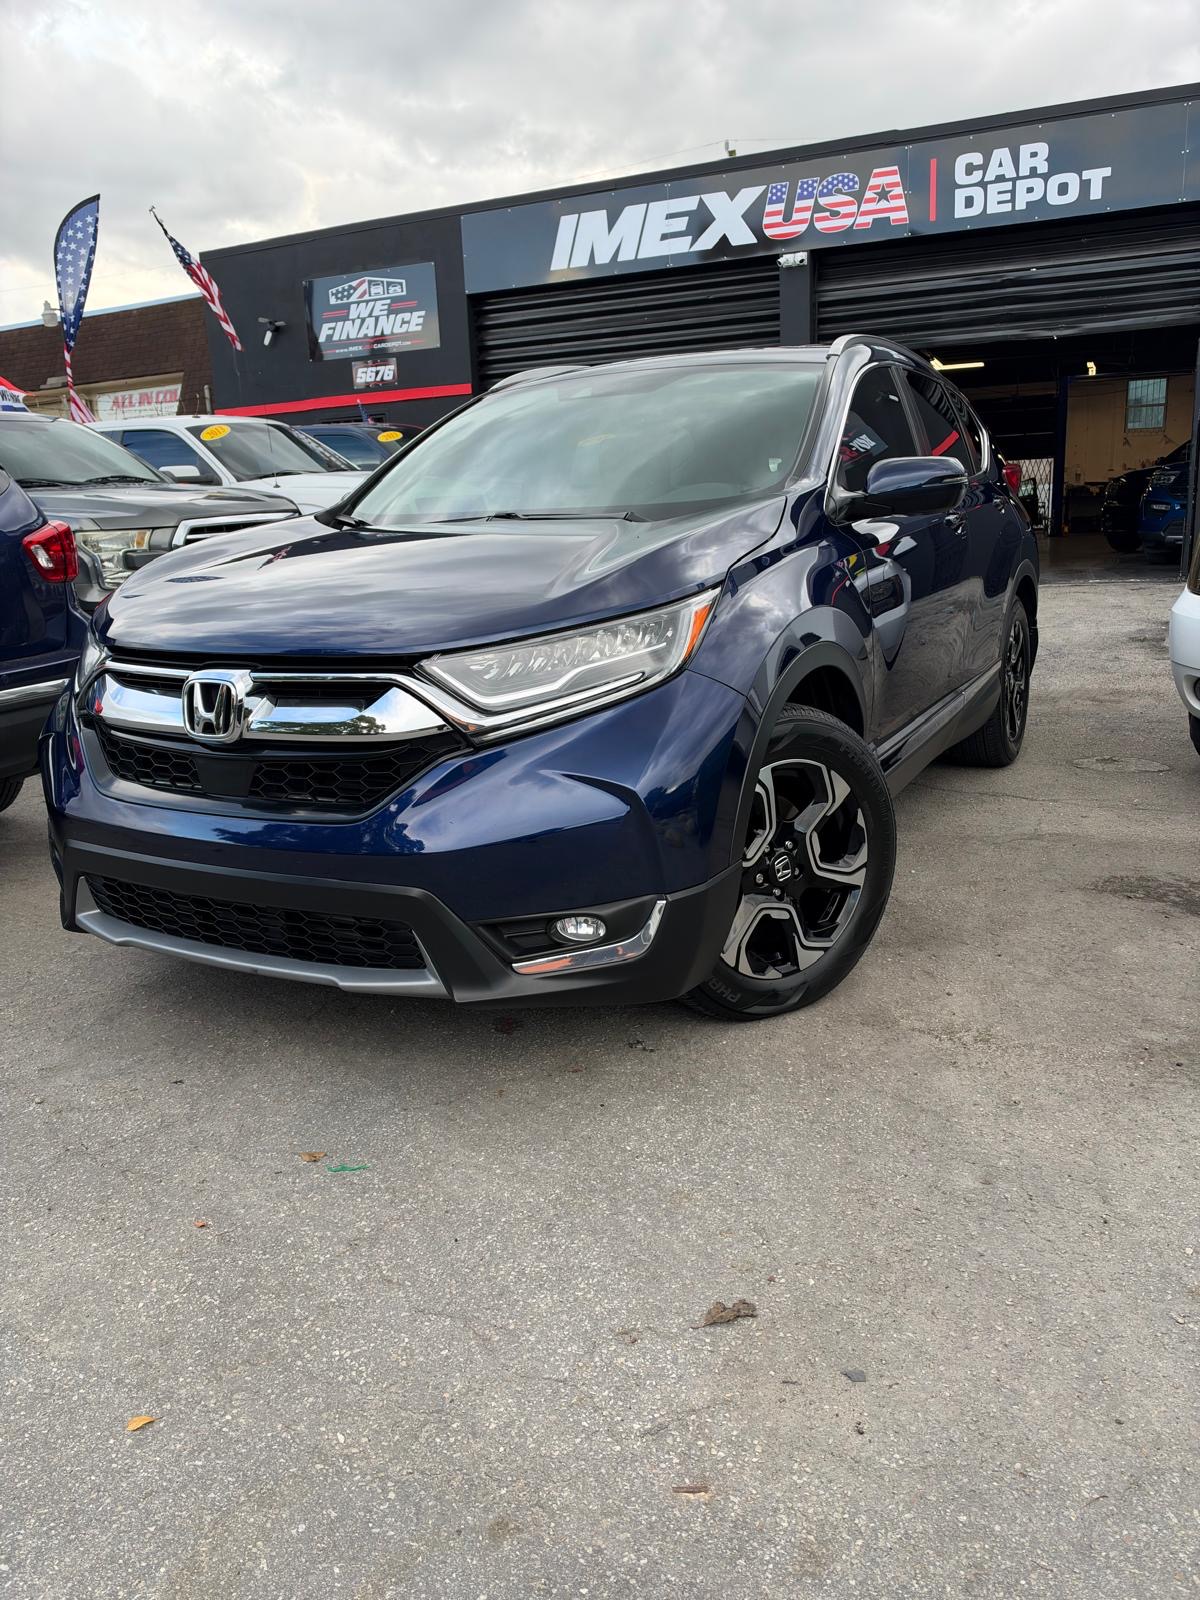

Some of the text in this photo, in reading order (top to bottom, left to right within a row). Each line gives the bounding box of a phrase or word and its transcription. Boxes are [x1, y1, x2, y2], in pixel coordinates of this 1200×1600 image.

[954, 142, 1049, 185] CAR
[954, 166, 1112, 219] DEPOT
[348, 299, 391, 319] WE
[318, 310, 426, 343] FINANCE
[356, 365, 394, 383] 5676
